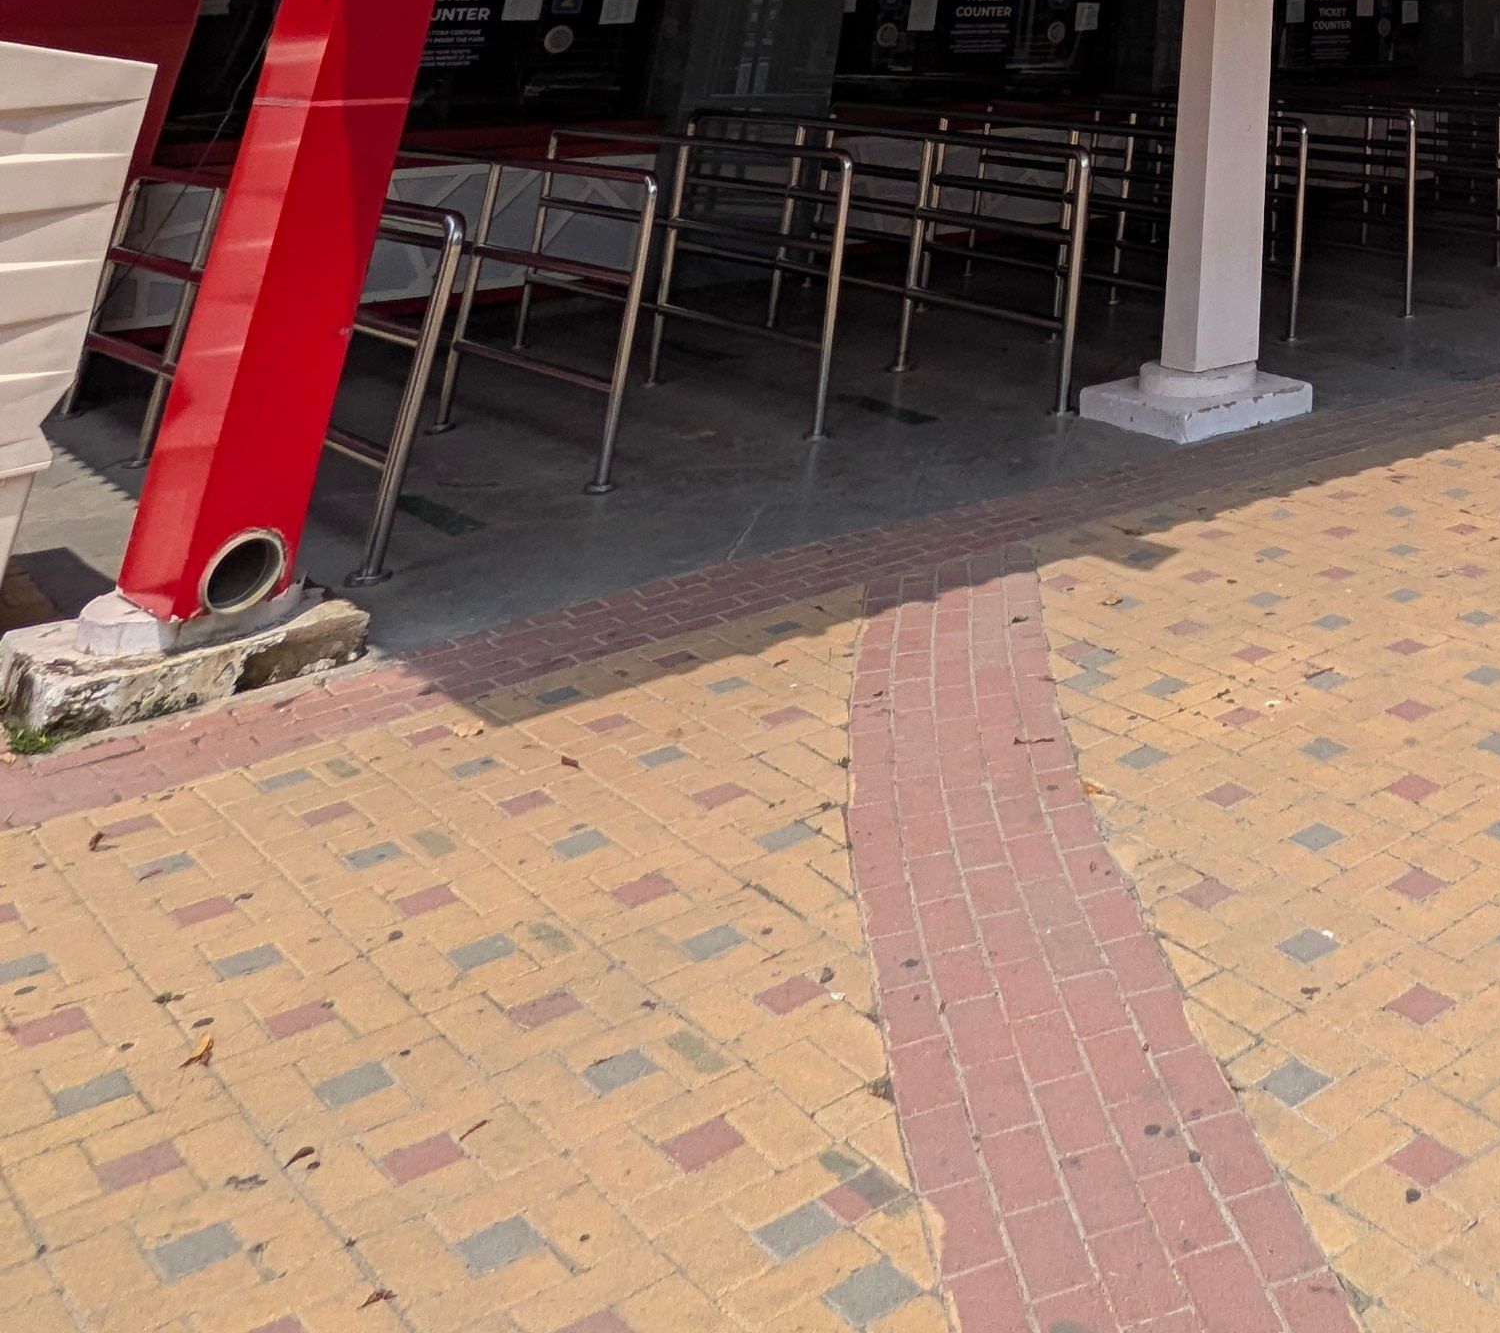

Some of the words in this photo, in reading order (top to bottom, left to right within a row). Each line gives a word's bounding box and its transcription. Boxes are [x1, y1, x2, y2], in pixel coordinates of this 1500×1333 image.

[430, 7, 492, 22] UNTER
[955, 5, 1013, 18] COUNTER
[1312, 20, 1352, 31] COUNTER
